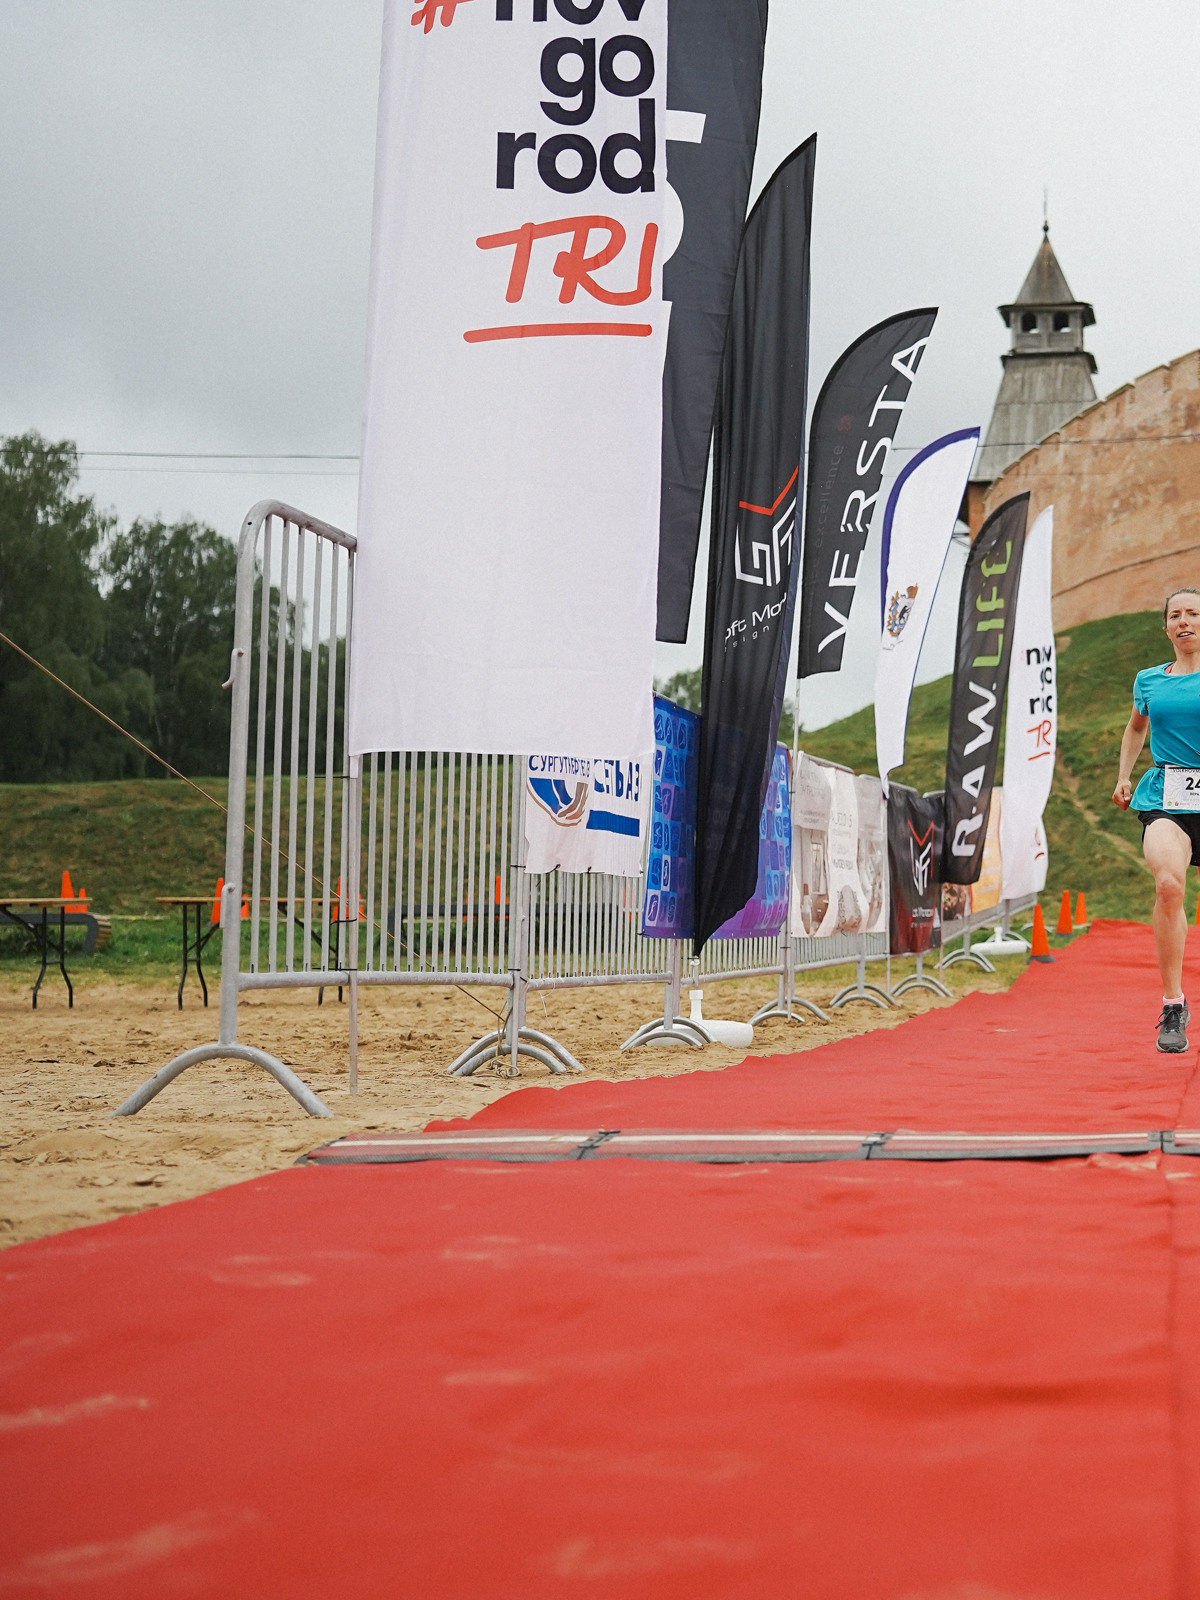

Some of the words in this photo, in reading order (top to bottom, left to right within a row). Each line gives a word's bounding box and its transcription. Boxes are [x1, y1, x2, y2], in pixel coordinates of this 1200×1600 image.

[540, 34, 656, 126] go
[496, 97, 656, 194] rod
[475, 215, 659, 306] TRI
